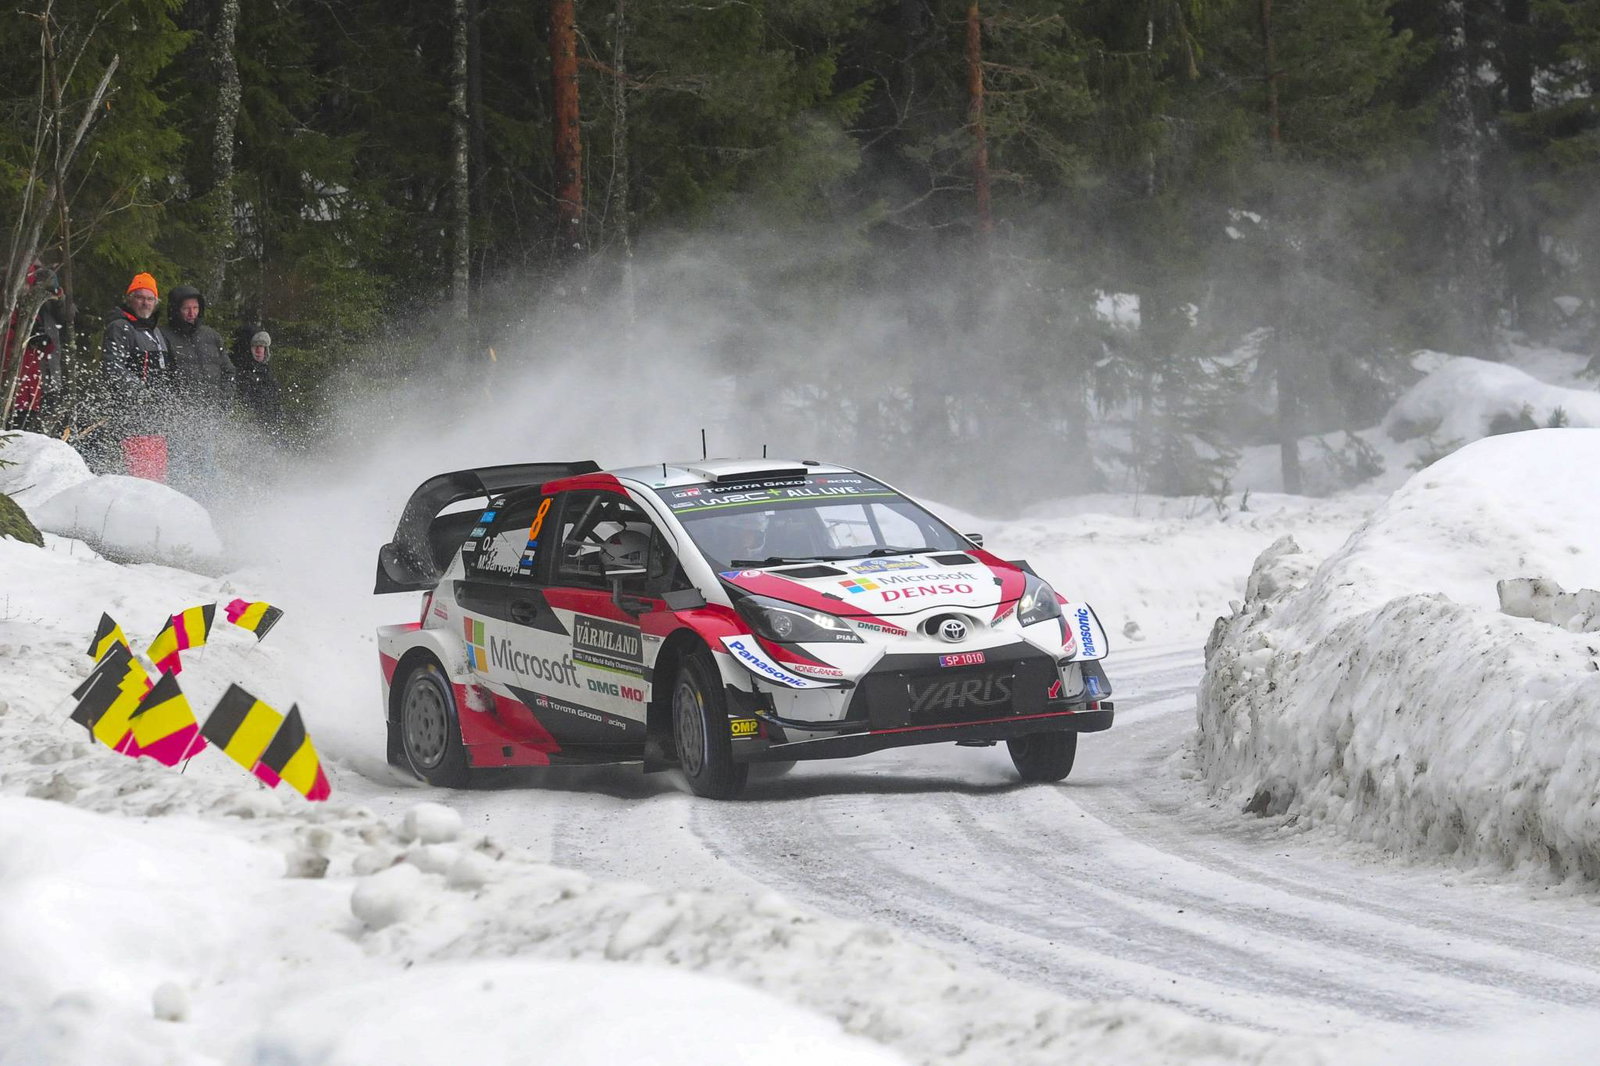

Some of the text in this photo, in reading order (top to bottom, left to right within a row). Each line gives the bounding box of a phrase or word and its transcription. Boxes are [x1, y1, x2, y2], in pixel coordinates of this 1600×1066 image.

[704, 483, 760, 493] TOYOTA
[786, 487, 820, 497] ALL
[822, 486, 859, 494] LIVE
[529, 498, 551, 540] 8
[878, 572, 976, 585] Microsoft
[881, 583, 974, 603] DENSO
[857, 621, 908, 637] DMG MORI
[1075, 603, 1097, 657] Panasonic
[576, 621, 638, 655] VÄRMLAND
[490, 636, 580, 688] Microsoft
[729, 640, 807, 687] Panasonic
[945, 653, 983, 666] SP 1010
[794, 664, 844, 677] KONECRANES
[586, 678, 620, 697] DMG
[549, 702, 577, 716] TOYOTA
[731, 721, 758, 733] OMP
